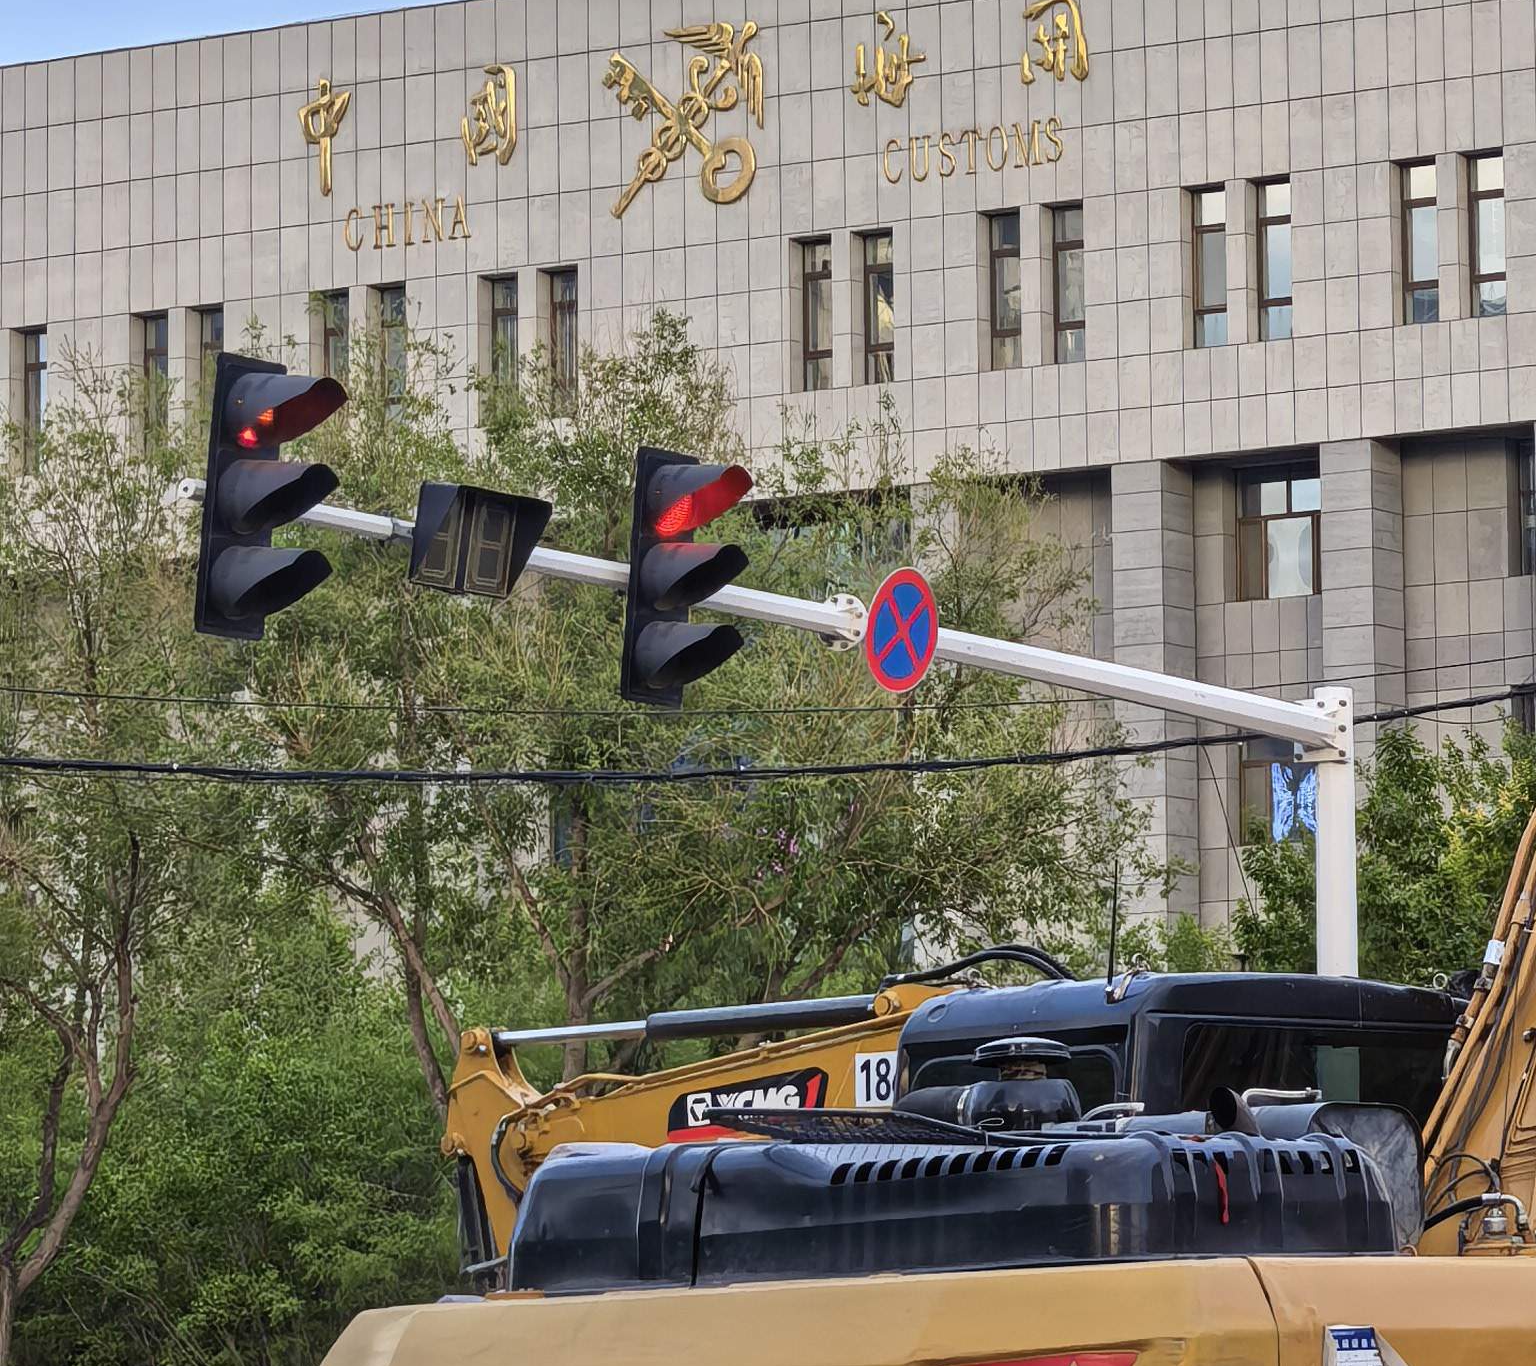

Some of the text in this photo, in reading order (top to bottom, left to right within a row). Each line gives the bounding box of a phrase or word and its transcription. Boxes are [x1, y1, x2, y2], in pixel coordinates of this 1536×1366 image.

[343, 115, 1064, 252] CHINA CUSTOMS
[860, 1058, 896, 1102] 18
